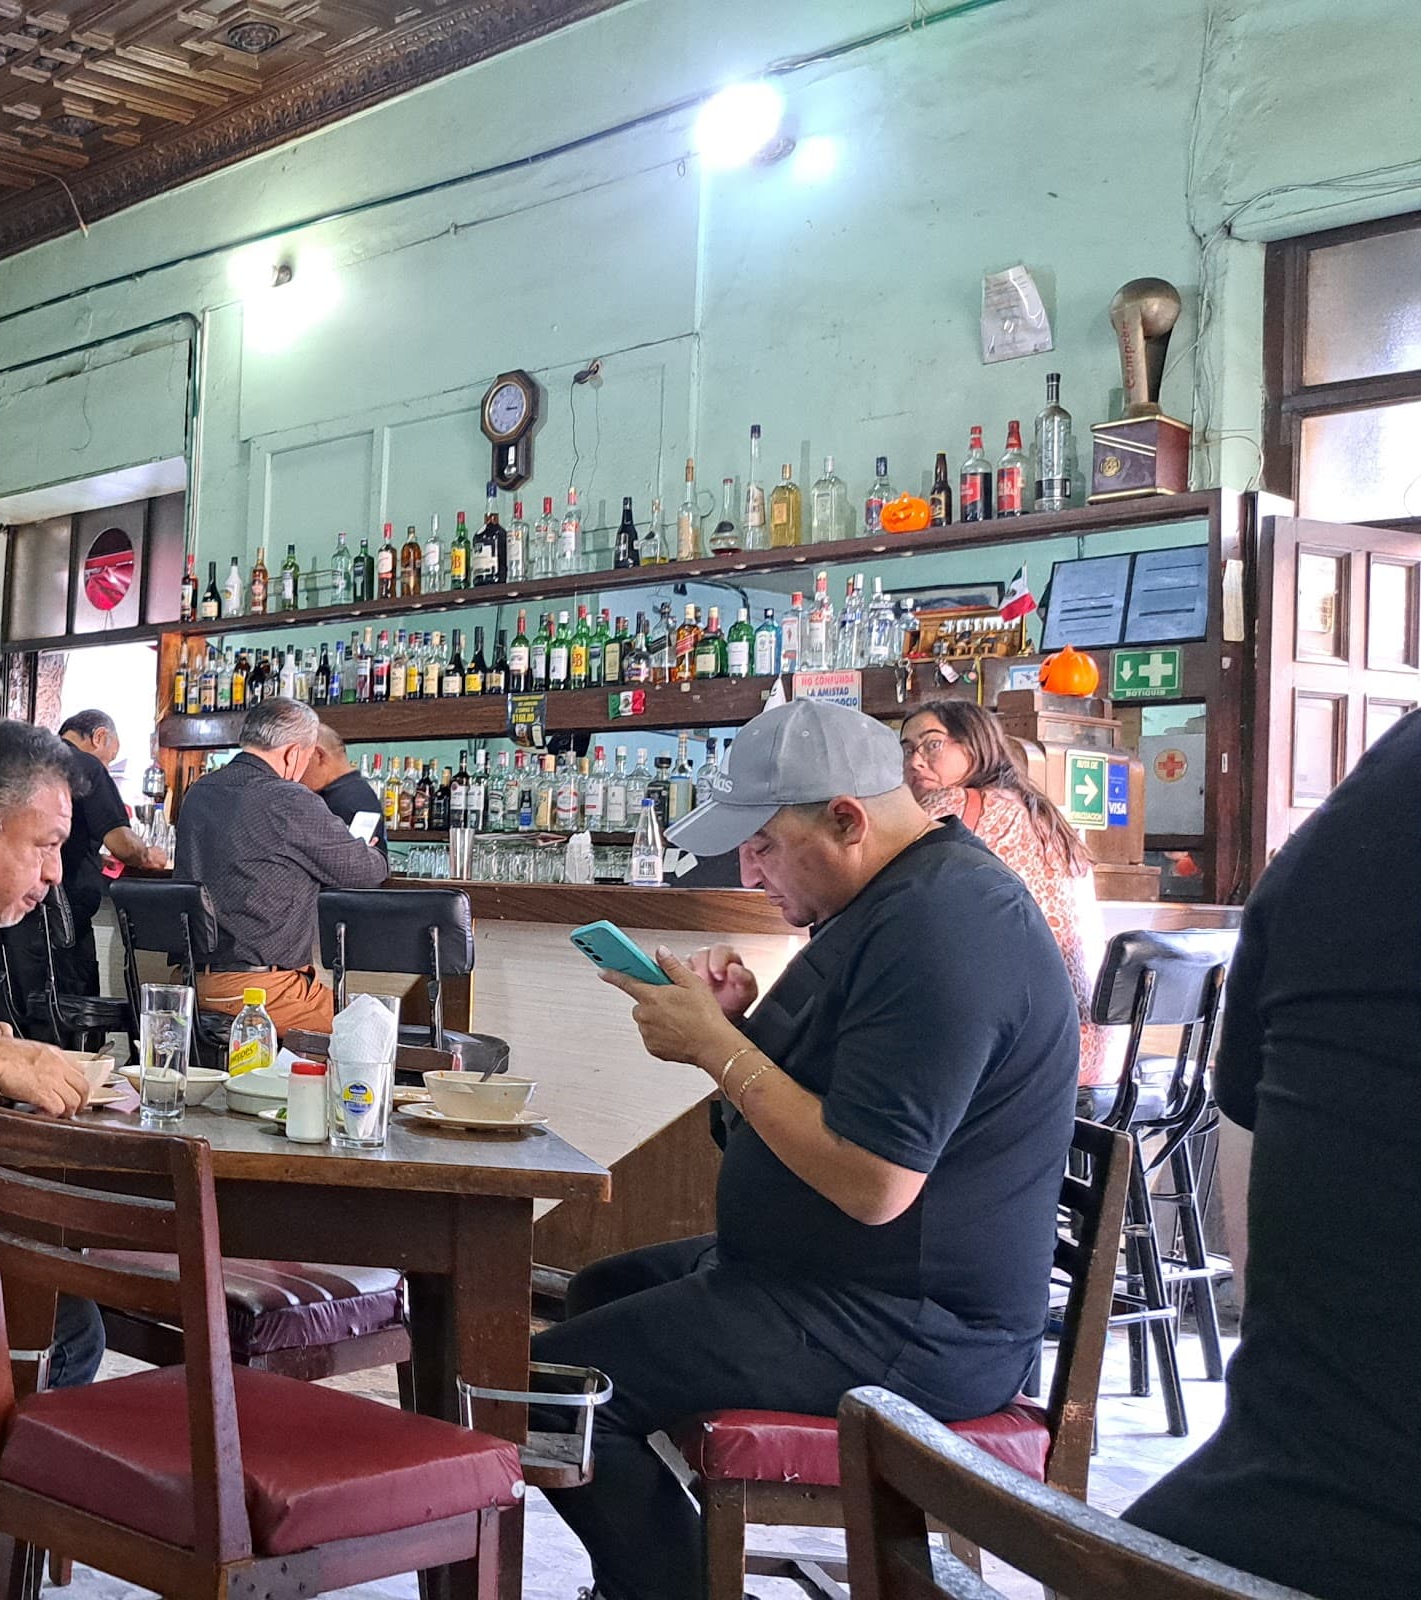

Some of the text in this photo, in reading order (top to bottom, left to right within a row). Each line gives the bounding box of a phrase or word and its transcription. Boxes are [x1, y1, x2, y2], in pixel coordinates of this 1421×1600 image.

[801, 674, 855, 686] NO CONFUNDA
[806, 687, 850, 697] LA AMISTAD
[1108, 801, 1127, 815] VISA
